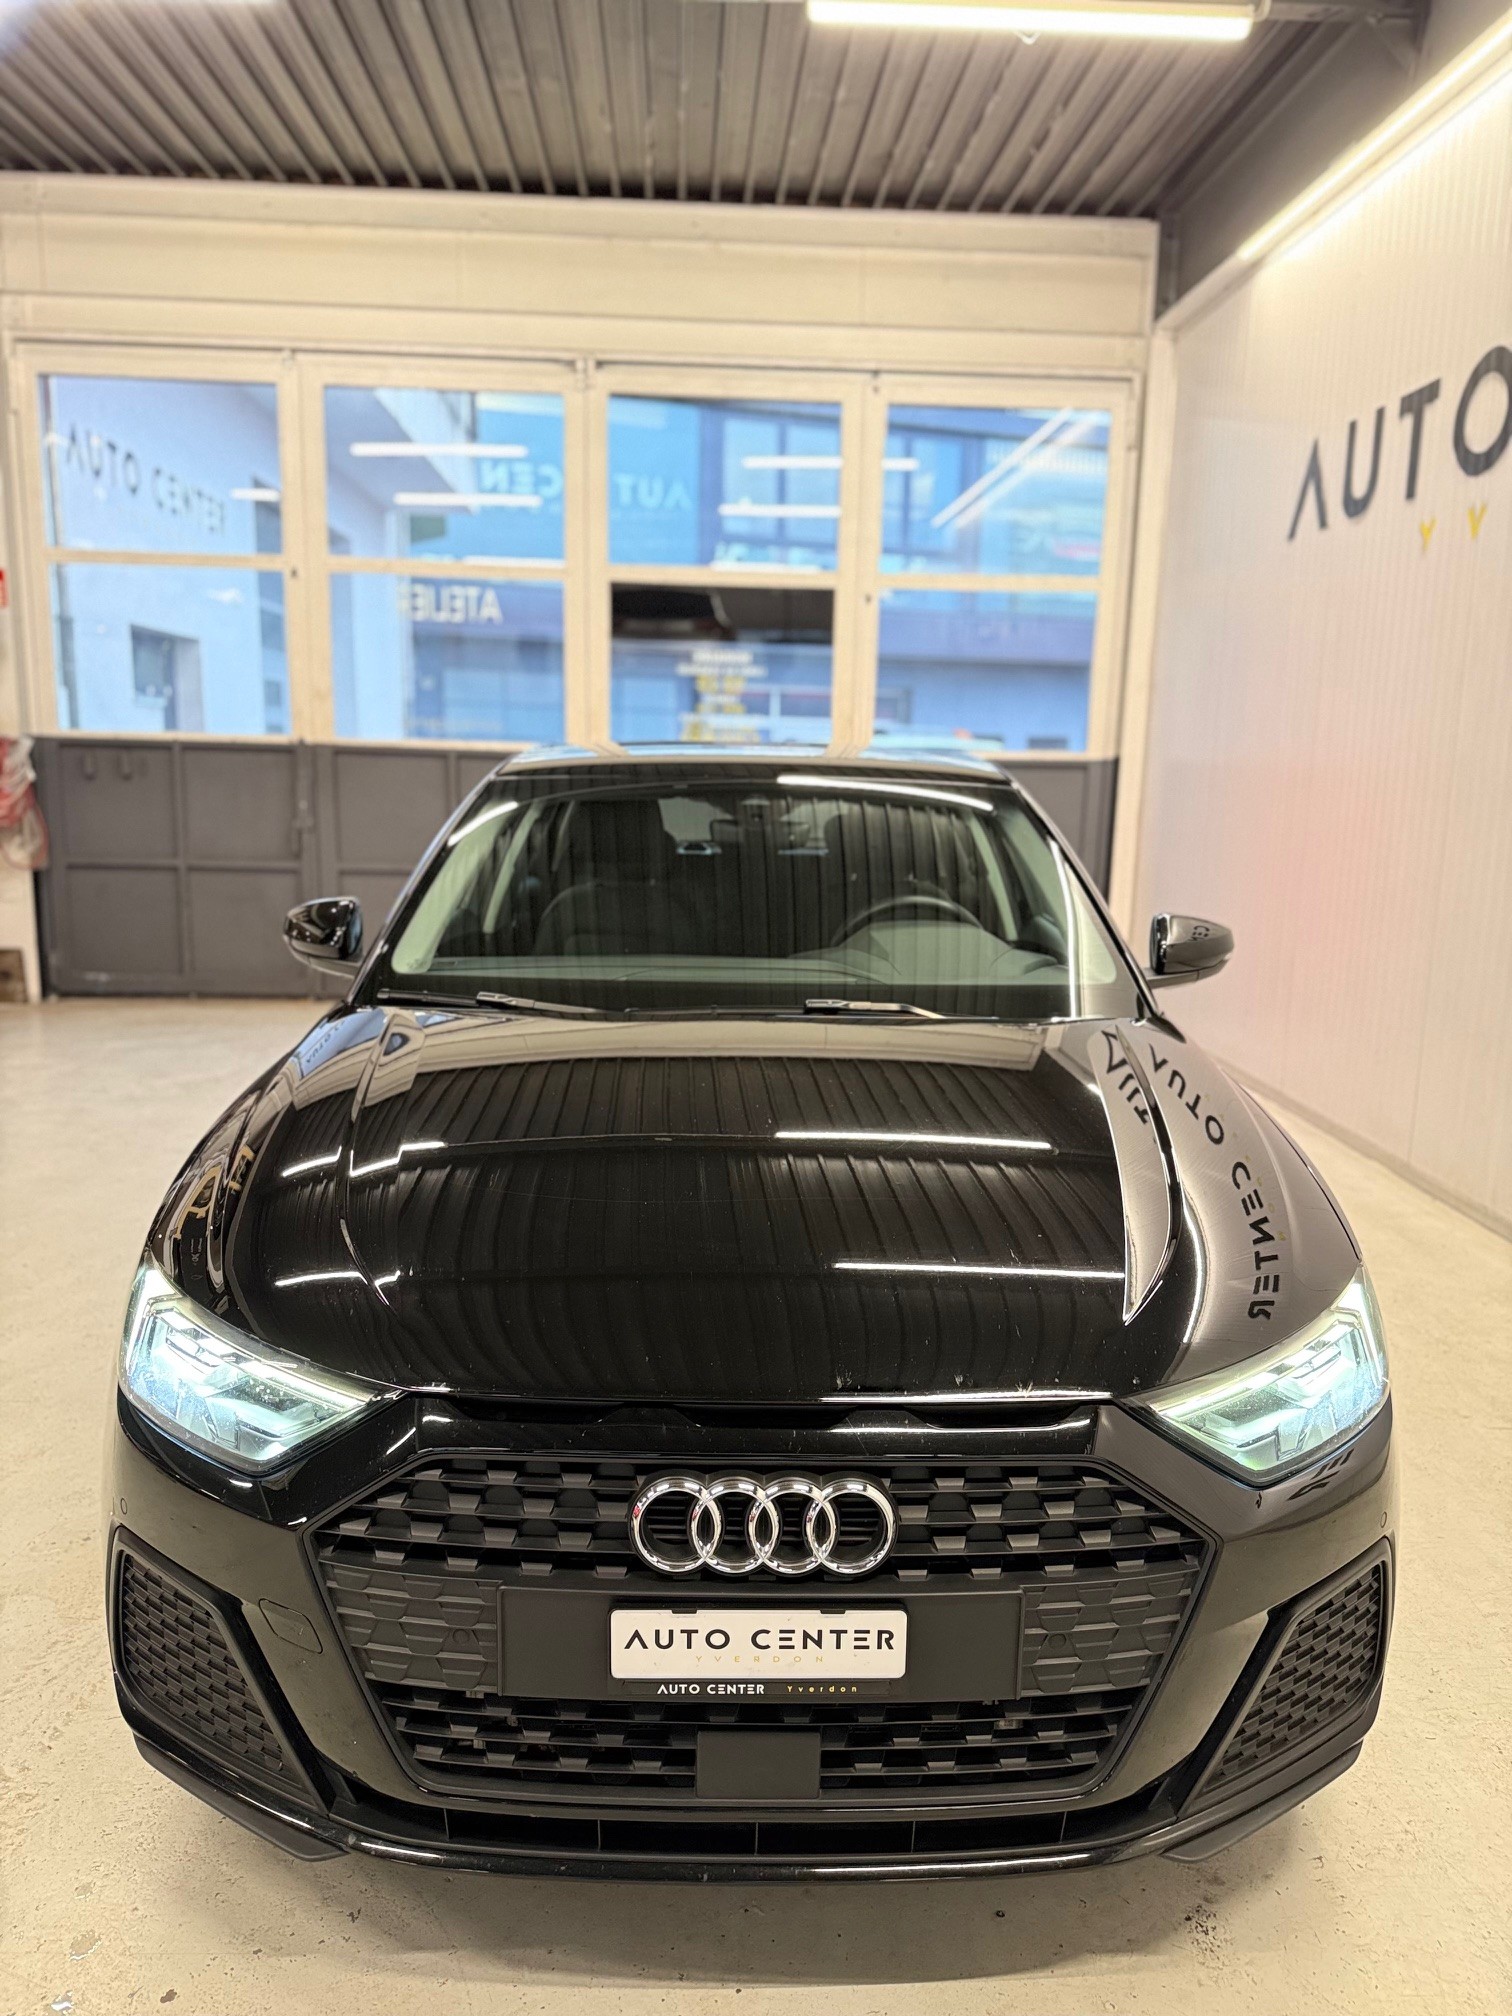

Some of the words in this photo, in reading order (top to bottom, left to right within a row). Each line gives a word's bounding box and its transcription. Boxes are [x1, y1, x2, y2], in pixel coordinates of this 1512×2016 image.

[66, 422, 140, 497] AUTO
[1287, 345, 1512, 541] AUTO
[624, 1629, 730, 1650] AUTO
[751, 1629, 895, 1650] CENTER
[657, 1684, 700, 1695] AUTO
[707, 1684, 765, 1695] CENTER
[787, 1685, 857, 1693] Yverdon
